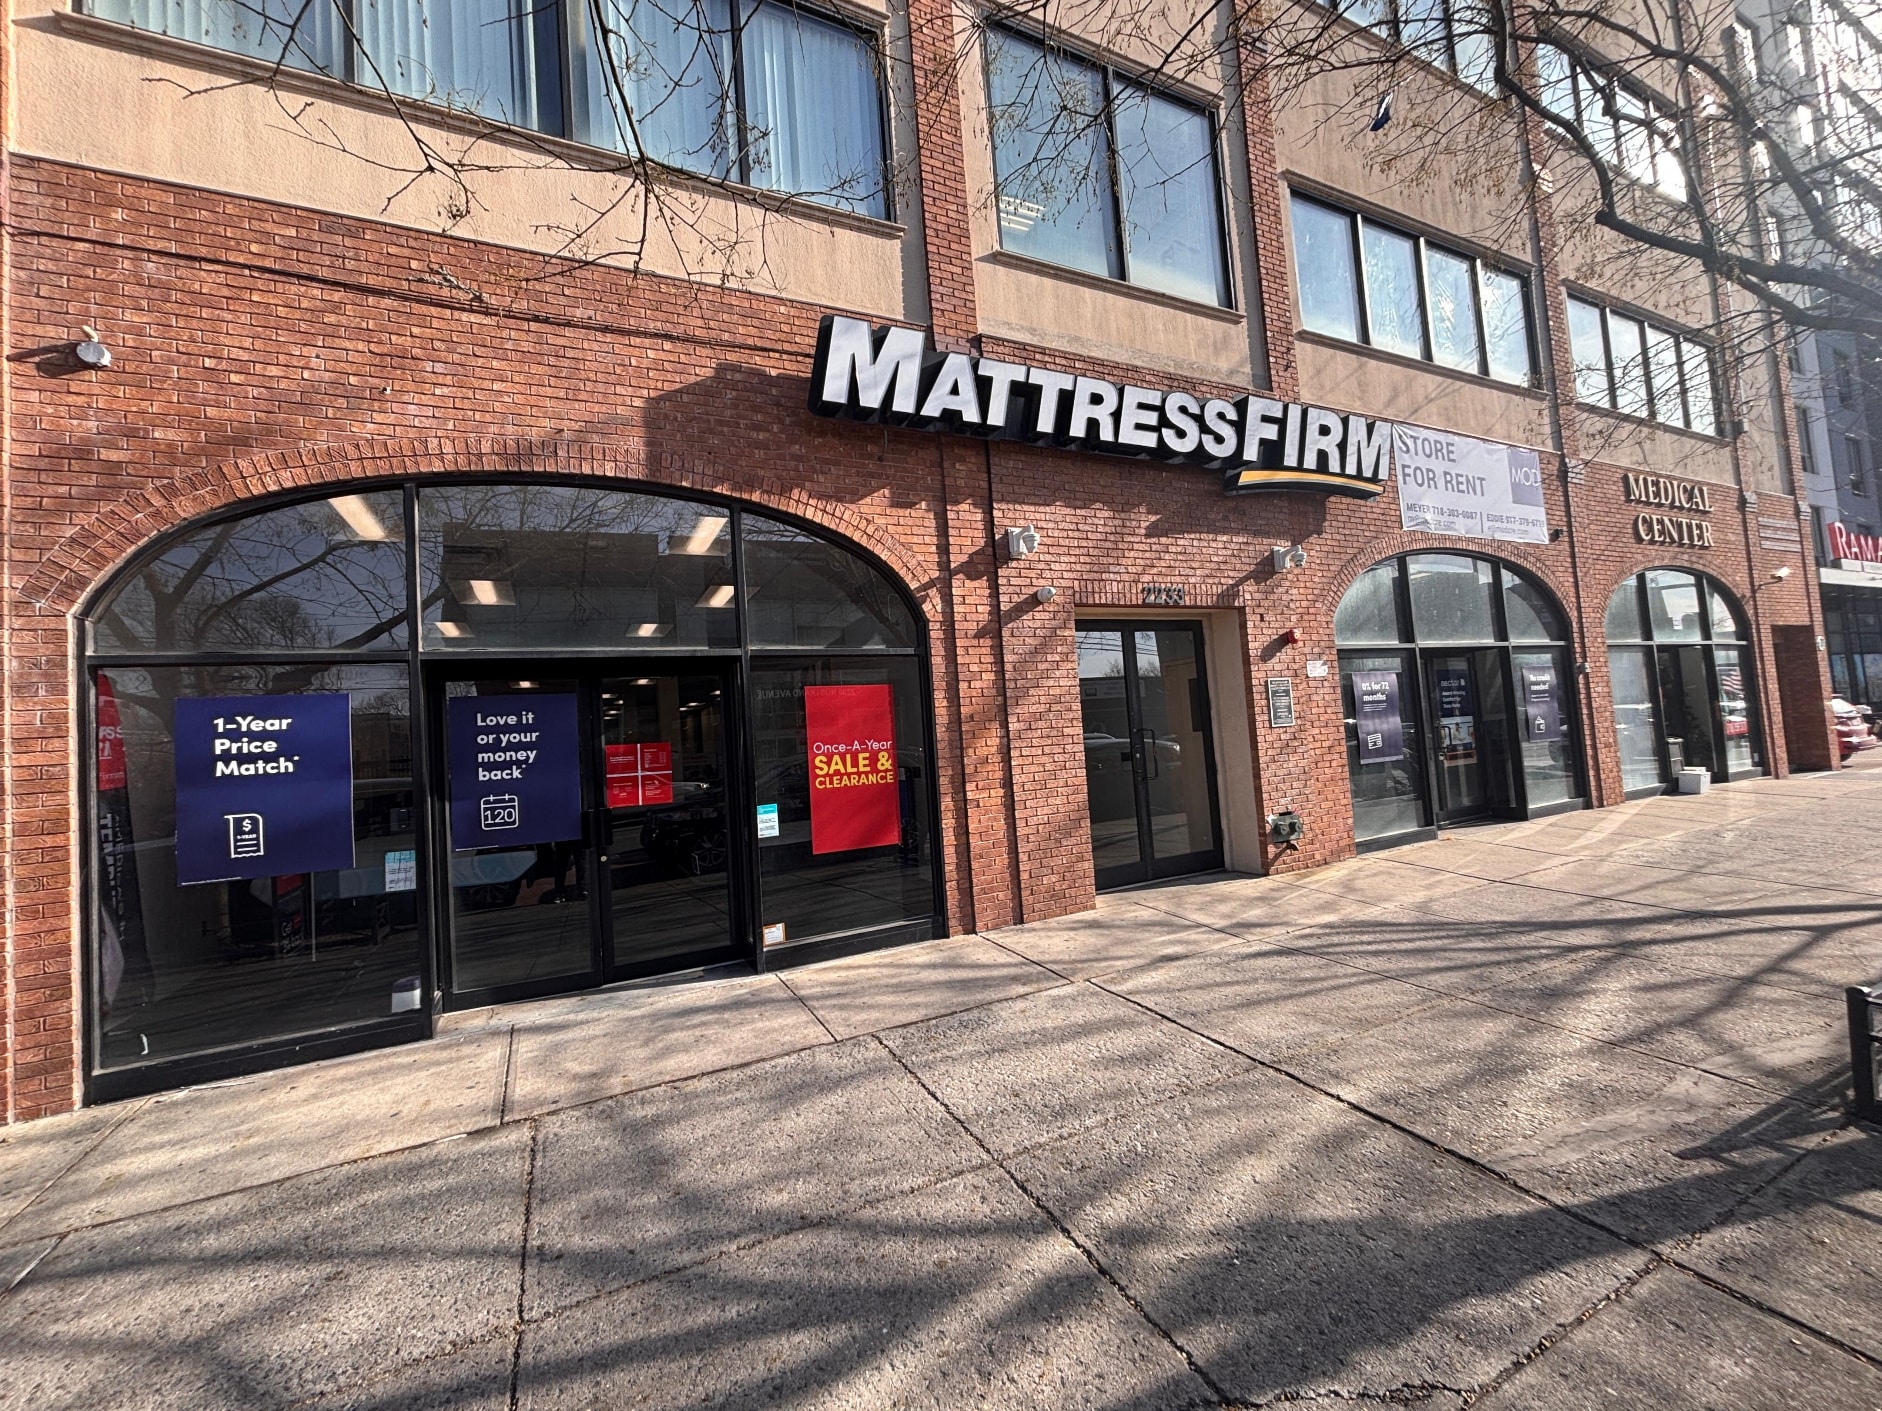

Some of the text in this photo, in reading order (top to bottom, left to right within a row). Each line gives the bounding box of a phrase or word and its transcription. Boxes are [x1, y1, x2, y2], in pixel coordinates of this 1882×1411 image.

[1399, 434, 1457, 464] STORE
[1401, 463, 1486, 497] FOR RENT
[1627, 473, 1714, 512] MEDICAL
[1406, 502, 1431, 514] MEYER
[1637, 513, 1715, 547] CENTER
[1142, 584, 1185, 605] 2233
[1361, 682, 1372, 691] 0%
[1371, 681, 1381, 690] for
[213, 715, 293, 733] 1-Year
[476, 711, 535, 726] Love it
[214, 737, 278, 755] Price
[476, 731, 540, 747] or your
[813, 739, 893, 754] Once-A-Year
[477, 750, 537, 764] money
[814, 751, 893, 776] SALE &
[815, 771, 895, 790] CLEARANCE
[484, 808, 516, 824] 120
